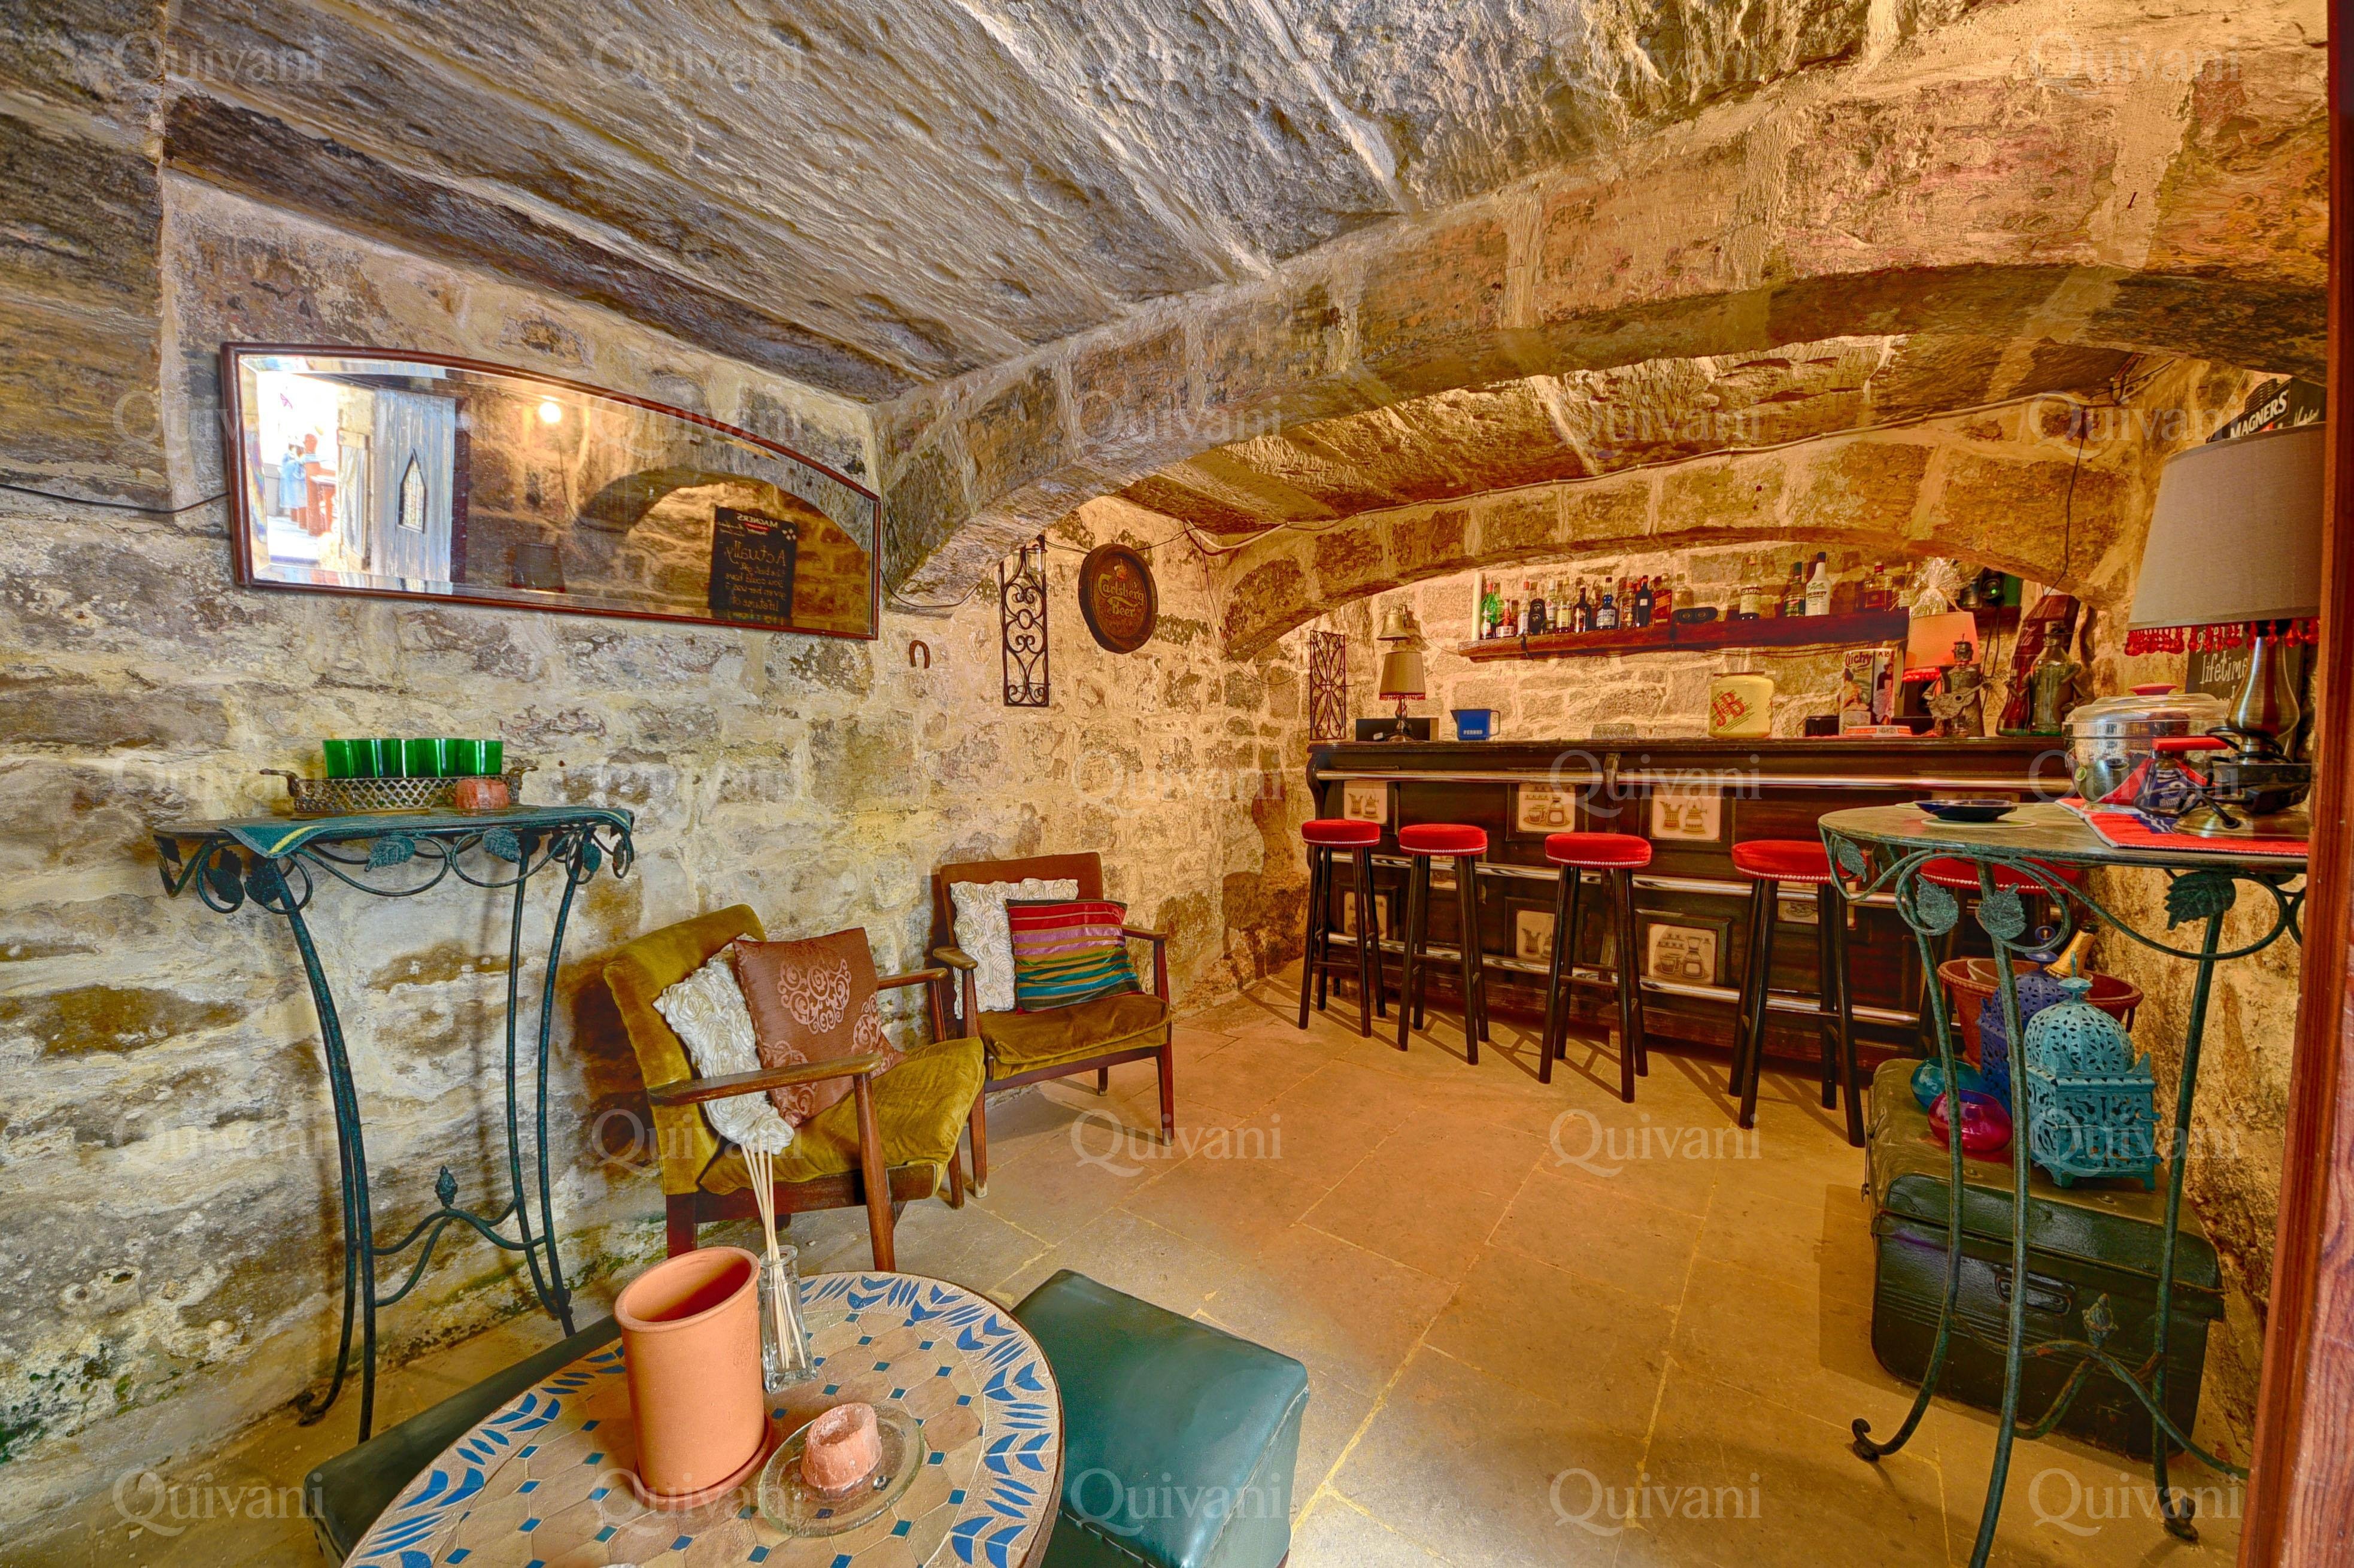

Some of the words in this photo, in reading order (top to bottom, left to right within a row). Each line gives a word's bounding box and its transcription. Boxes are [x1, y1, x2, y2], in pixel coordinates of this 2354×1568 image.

[2230, 389, 2289, 439] MAGNERS
[1098, 573, 1144, 606] Carlsberg
[1112, 600, 1135, 617] Beer
[2200, 650, 2248, 684] lifetime
